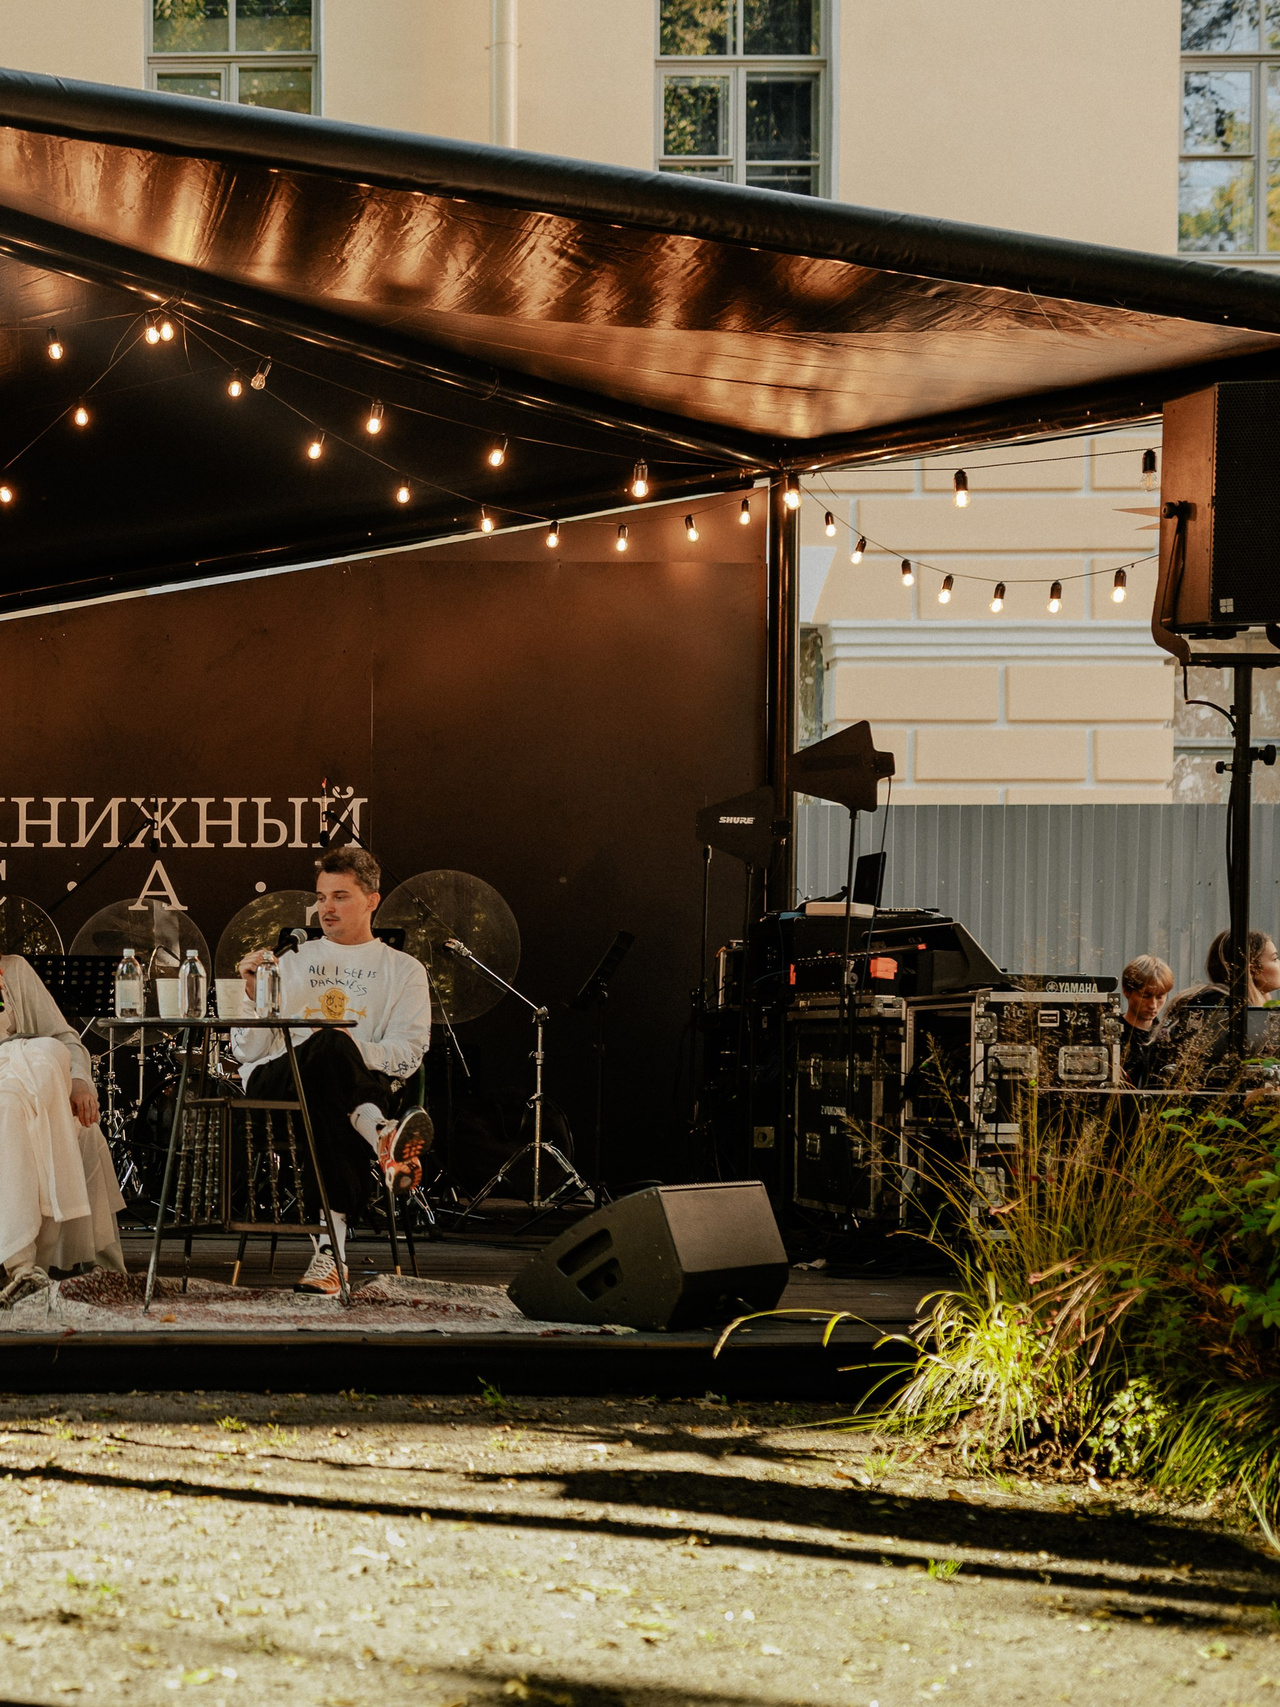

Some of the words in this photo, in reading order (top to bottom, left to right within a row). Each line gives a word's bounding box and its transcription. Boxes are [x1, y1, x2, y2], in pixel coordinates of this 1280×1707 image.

[719, 816, 755, 824] SHURE
[367, 970, 377, 979] IS
[1059, 982, 1098, 993] YAMAHA
